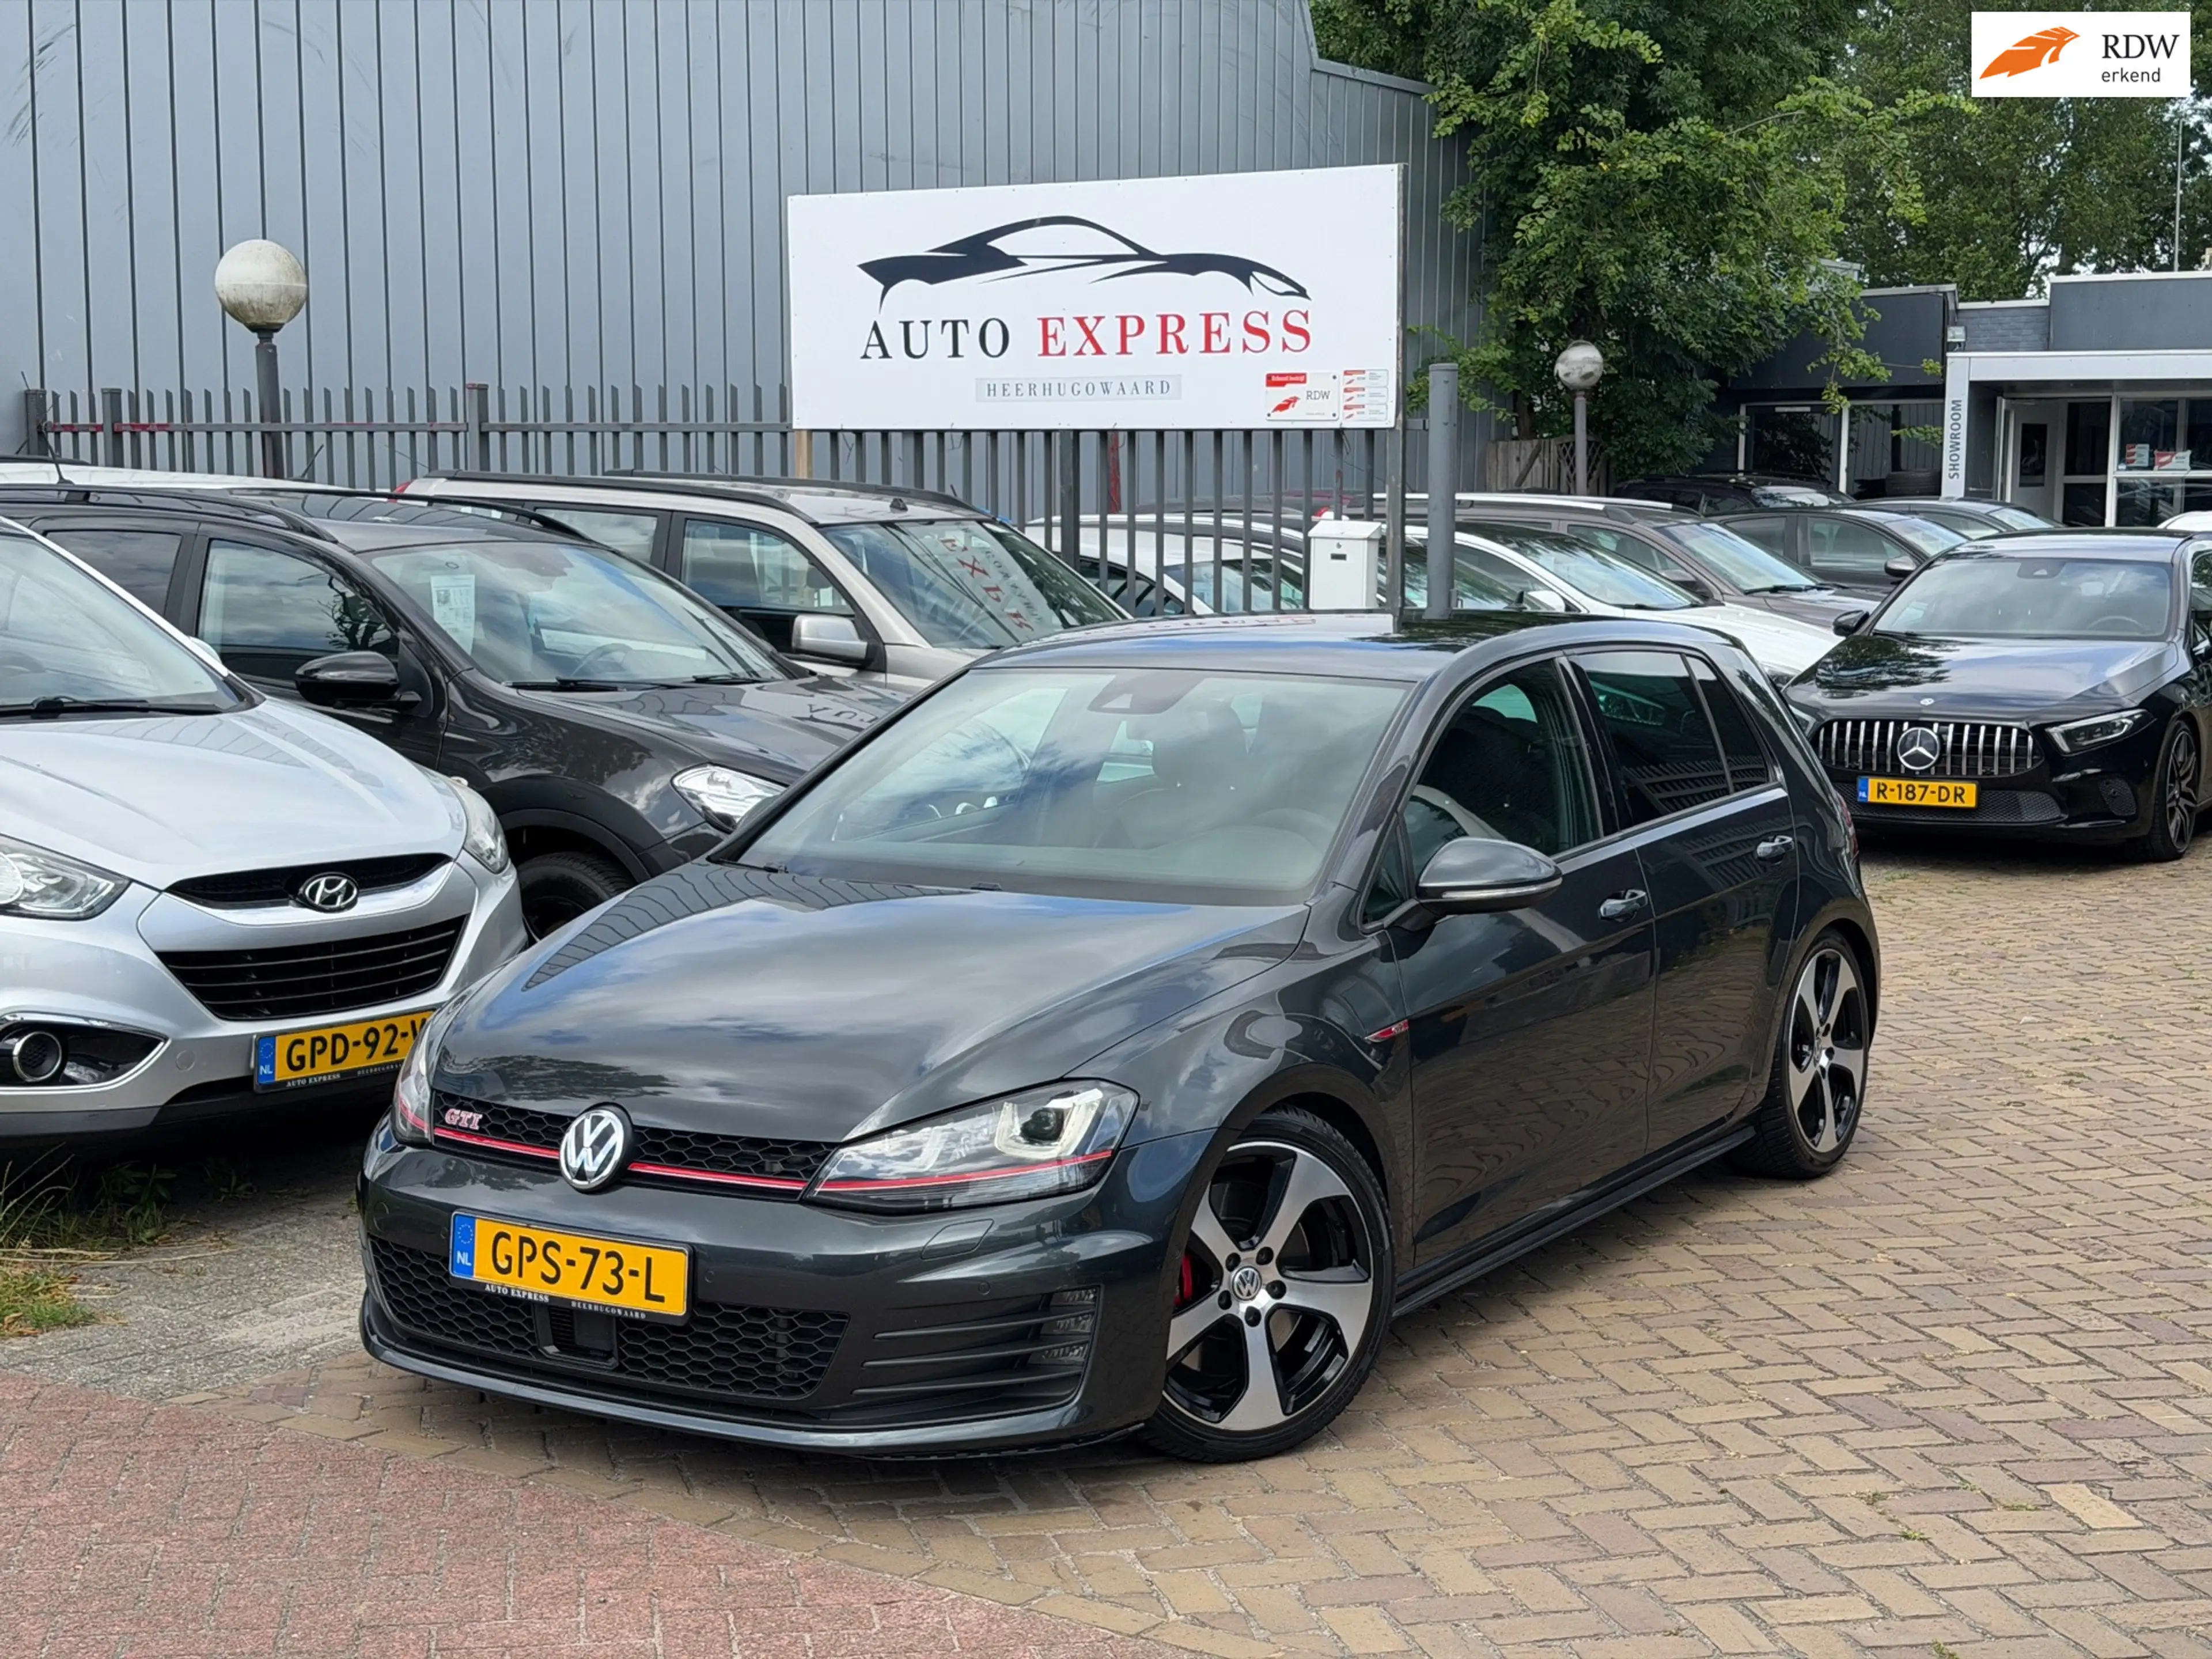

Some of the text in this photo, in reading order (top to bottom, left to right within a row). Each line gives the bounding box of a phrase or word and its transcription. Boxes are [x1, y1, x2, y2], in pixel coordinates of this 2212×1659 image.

[860, 310, 1310, 359] AUTO EXPRESS
[986, 381, 1171, 397] HEERHUGOWAARD
[1306, 390, 1331, 400] RDW
[1948, 399, 1963, 480] SHOWROOM
[1876, 781, 1965, 804] R-187-DR
[260, 1065, 273, 1075] NL
[286, 1073, 341, 1088] AUTO EXPRESS
[444, 1108, 483, 1130] GTI
[456, 1251, 472, 1267] NL
[491, 1230, 666, 1304] GPS-73-L
[484, 1283, 550, 1302] AUTO EXPRESS
